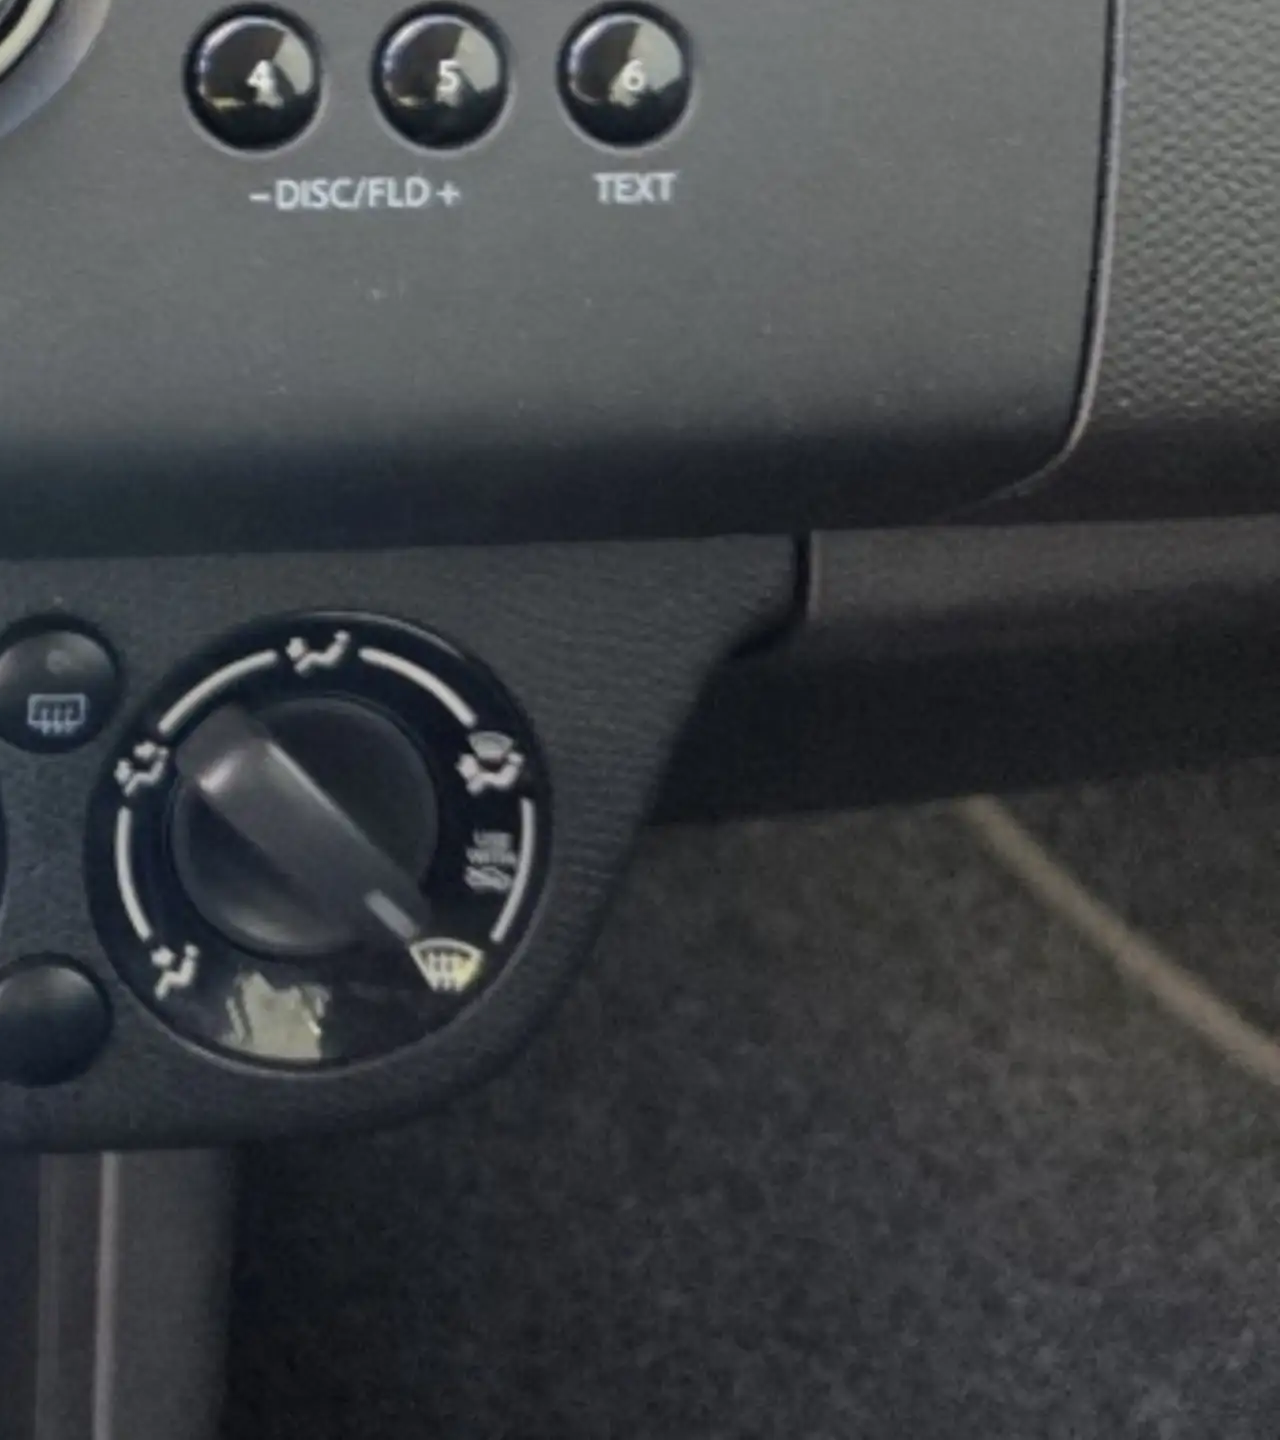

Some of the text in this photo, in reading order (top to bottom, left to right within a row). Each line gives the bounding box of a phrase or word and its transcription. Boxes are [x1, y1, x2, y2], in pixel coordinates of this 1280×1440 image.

[246, 59, 273, 93] 4
[438, 59, 462, 93] 5
[620, 58, 647, 94] 6
[592, 171, 678, 203] TEXT
